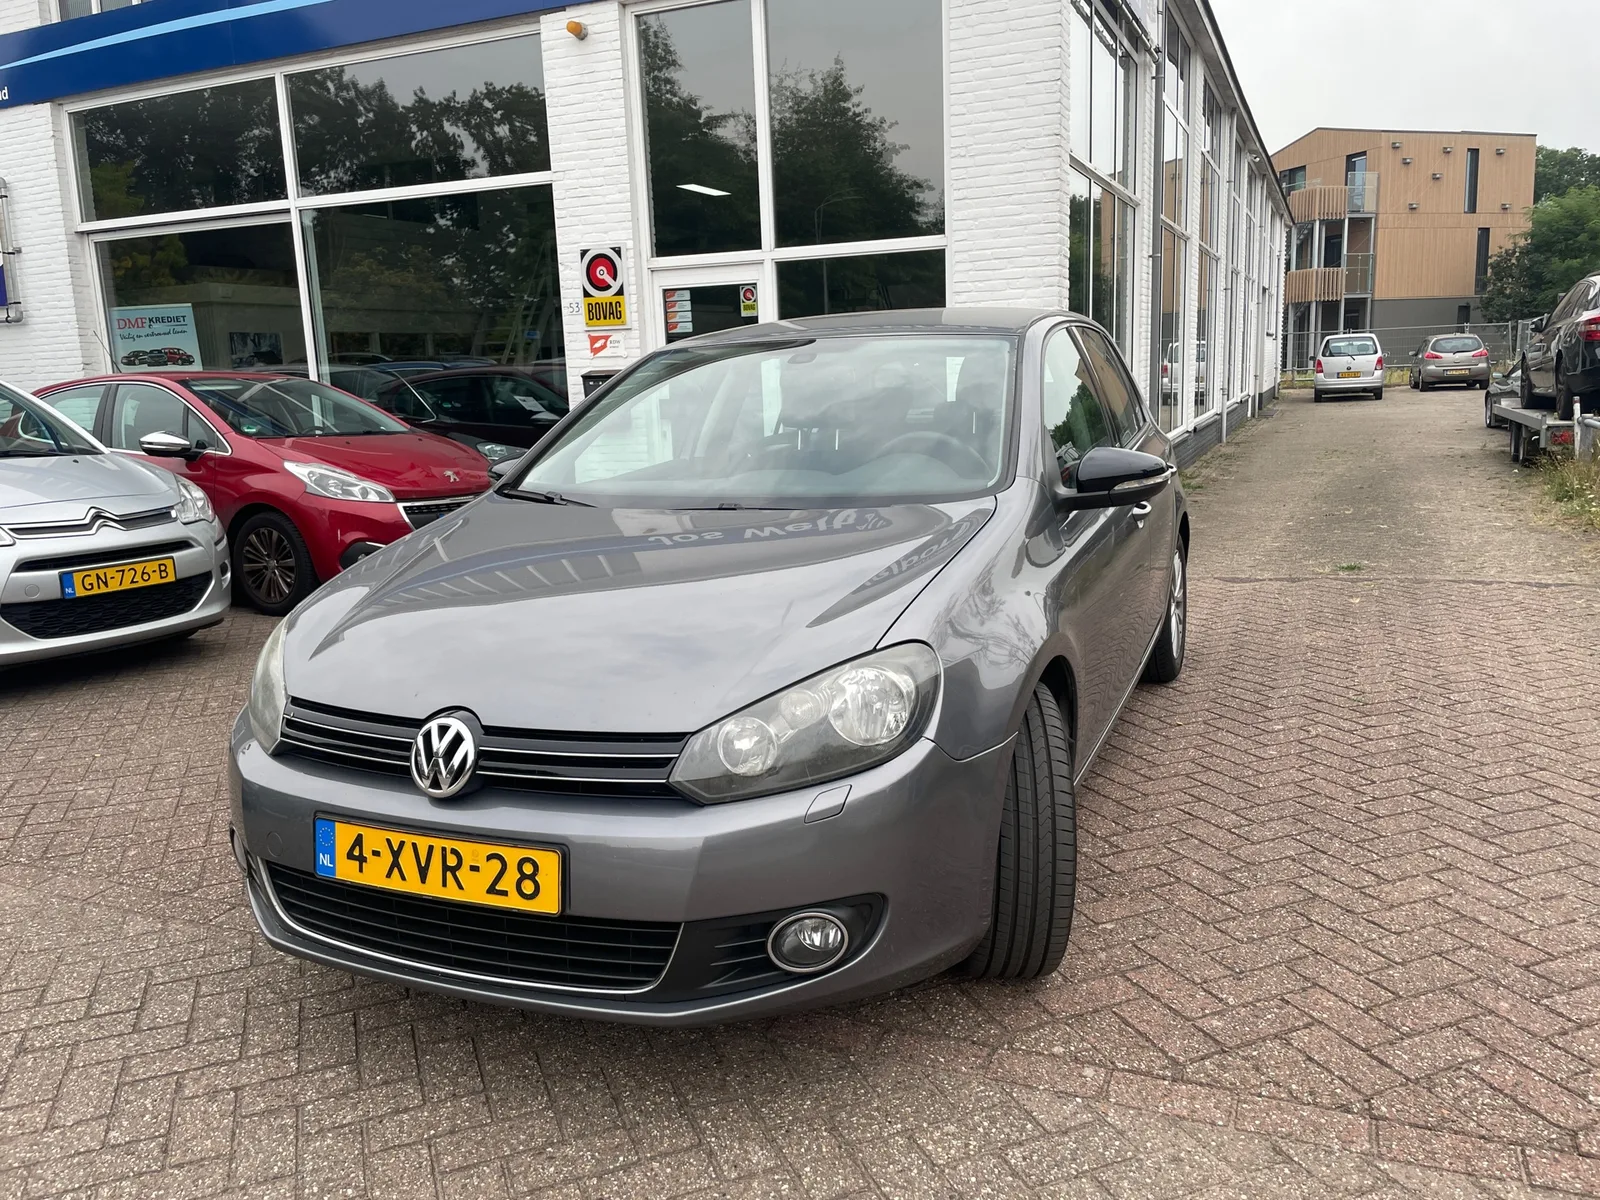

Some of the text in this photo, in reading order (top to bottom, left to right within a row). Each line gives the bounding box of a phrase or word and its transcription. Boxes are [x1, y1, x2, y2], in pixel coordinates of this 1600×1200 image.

[587, 301, 623, 321] BOVAG
[116, 315, 187, 330] DMF KREDIET
[81, 563, 169, 592] GN-726-B
[319, 852, 334, 867] NL
[346, 832, 541, 901] 4-XVR-28
